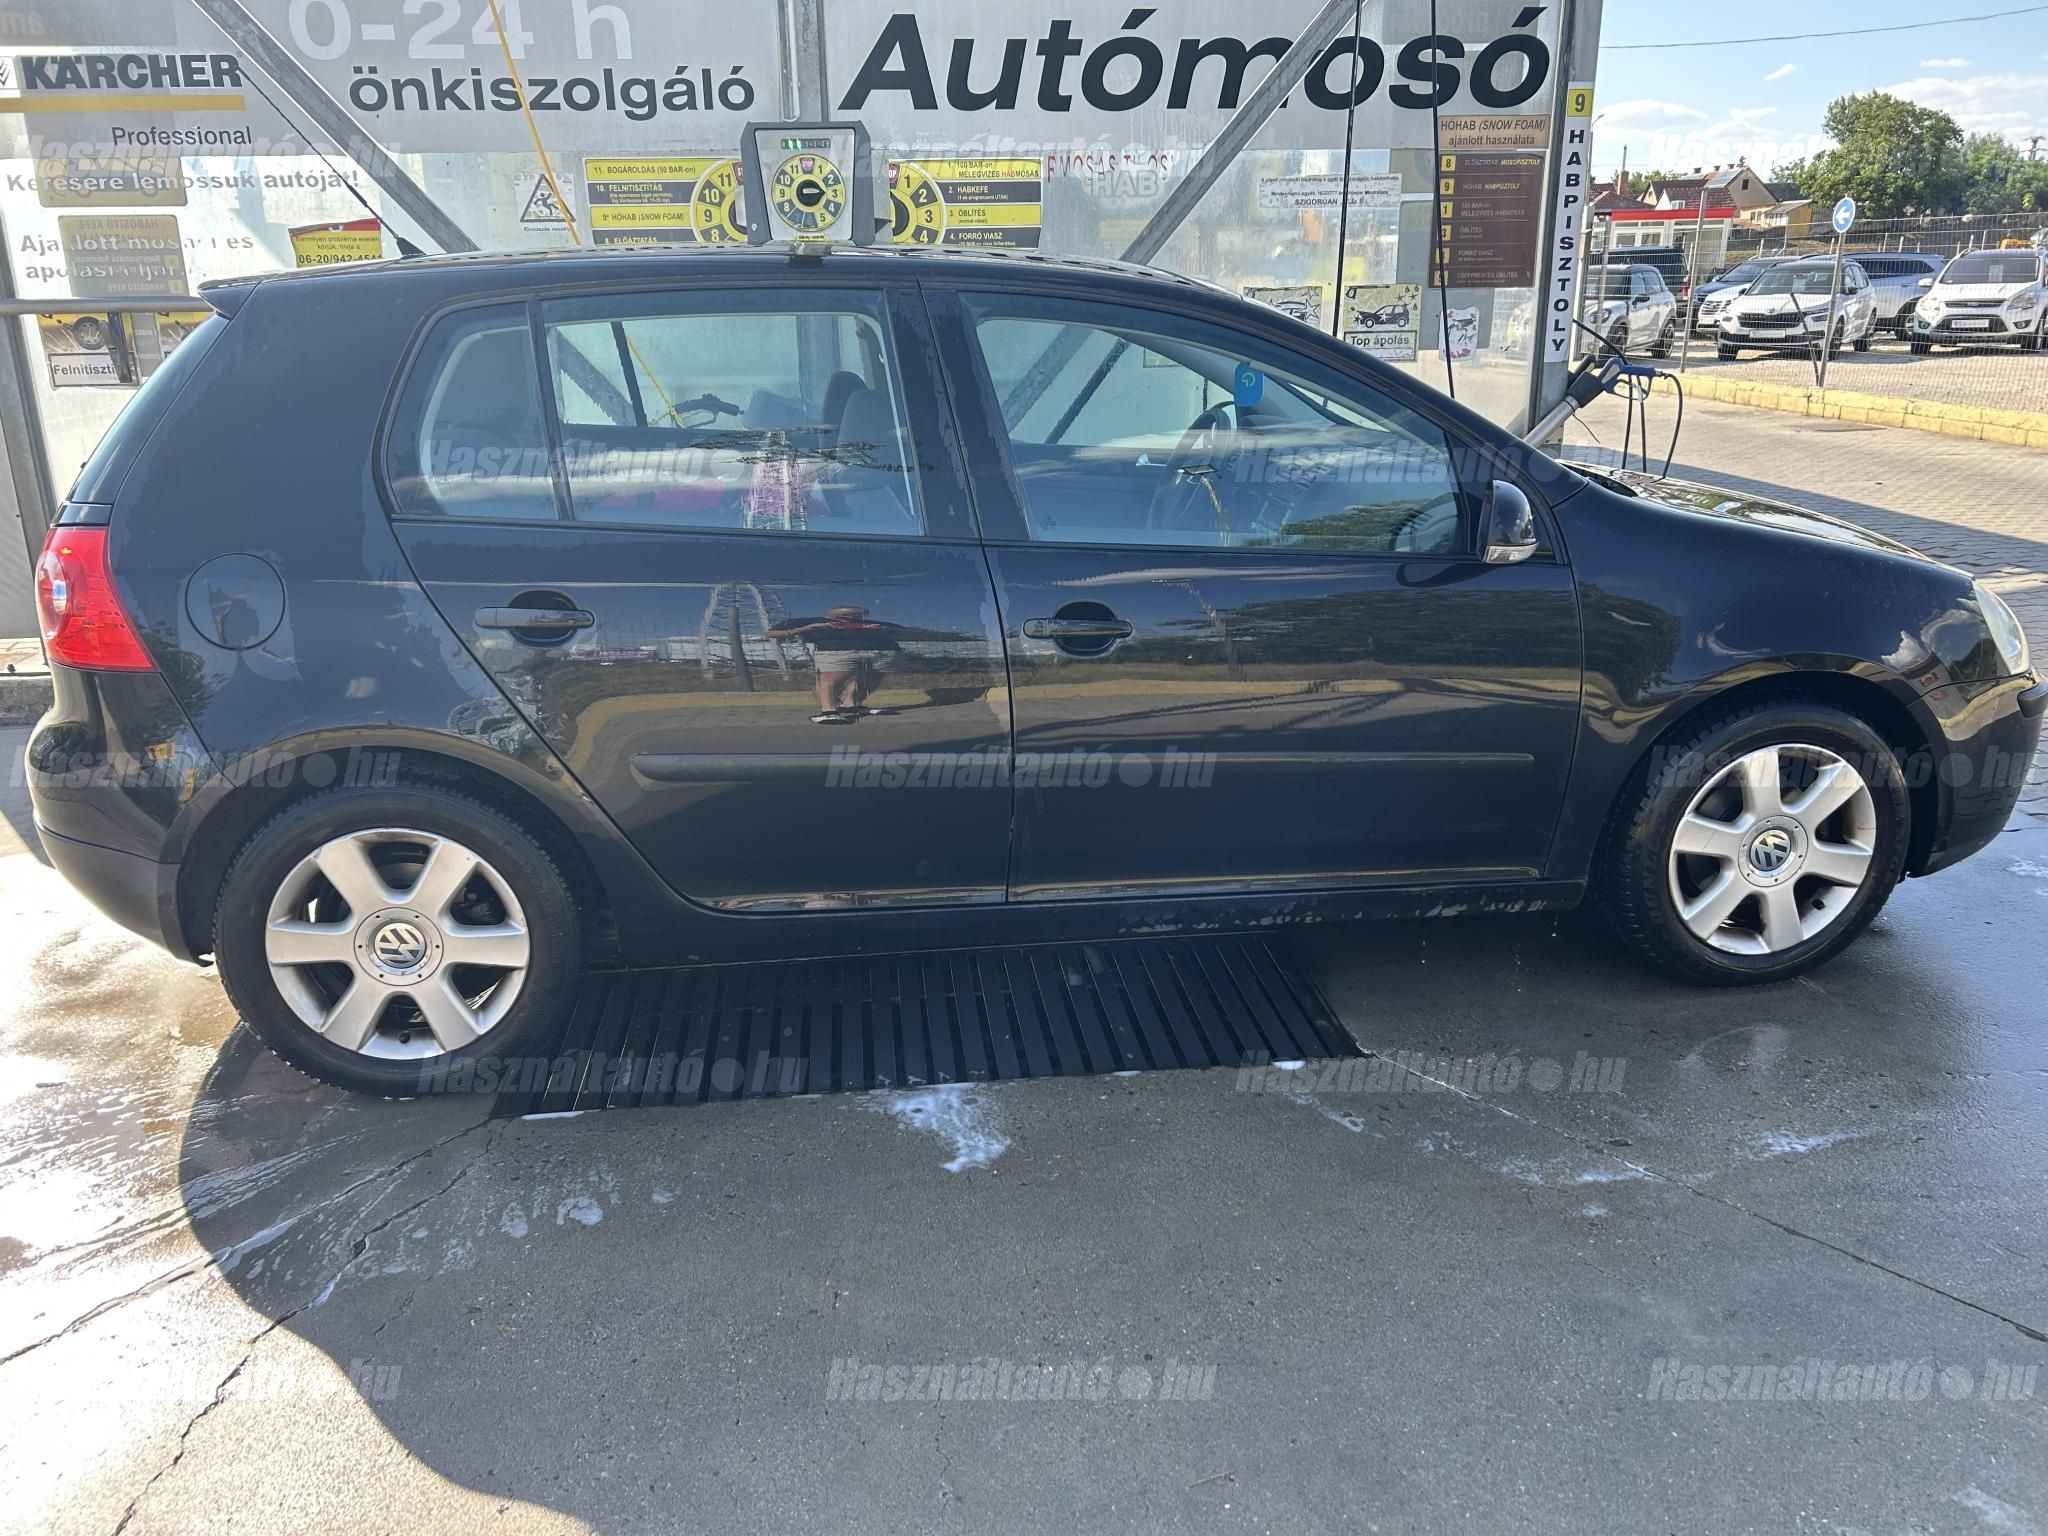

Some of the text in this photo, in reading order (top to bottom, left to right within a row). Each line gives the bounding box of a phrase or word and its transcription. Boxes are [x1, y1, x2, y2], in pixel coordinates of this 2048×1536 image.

[838, 6, 1551, 111] Autómosó
[20, 55, 243, 89] KÄRCHER
[349, 65, 755, 121] önkiszolgáló
[1574, 93, 1586, 113] 9
[1514, 119, 1546, 132] FOAM)
[112, 126, 253, 147] Professional
[1449, 134, 1535, 148] ajánlott használata
[607, 165, 656, 174] BOGÁROLDÁS
[1445, 158, 1452, 168] 8
[132, 171, 255, 190] lemossuk
[718, 173, 732, 187] 11
[780, 176, 791, 185] 10
[827, 174, 834, 184] 2
[904, 174, 911, 188] 1
[1444, 182, 1450, 191] 9
[702, 188, 719, 203] 10
[779, 189, 785, 198] 9
[832, 189, 838, 198] 3
[918, 189, 928, 203] 2
[828, 202, 835, 212] 4
[1442, 205, 1448, 215] 1
[704, 209, 713, 223] 9
[820, 213, 826, 222] 5
[924, 209, 934, 223] 3
[711, 229, 720, 242] 8
[919, 229, 929, 244] 4
[959, 232, 983, 240] FORRÓ
[983, 232, 1003, 240] VIASZ
[1350, 334, 1410, 347] Top ápolás
